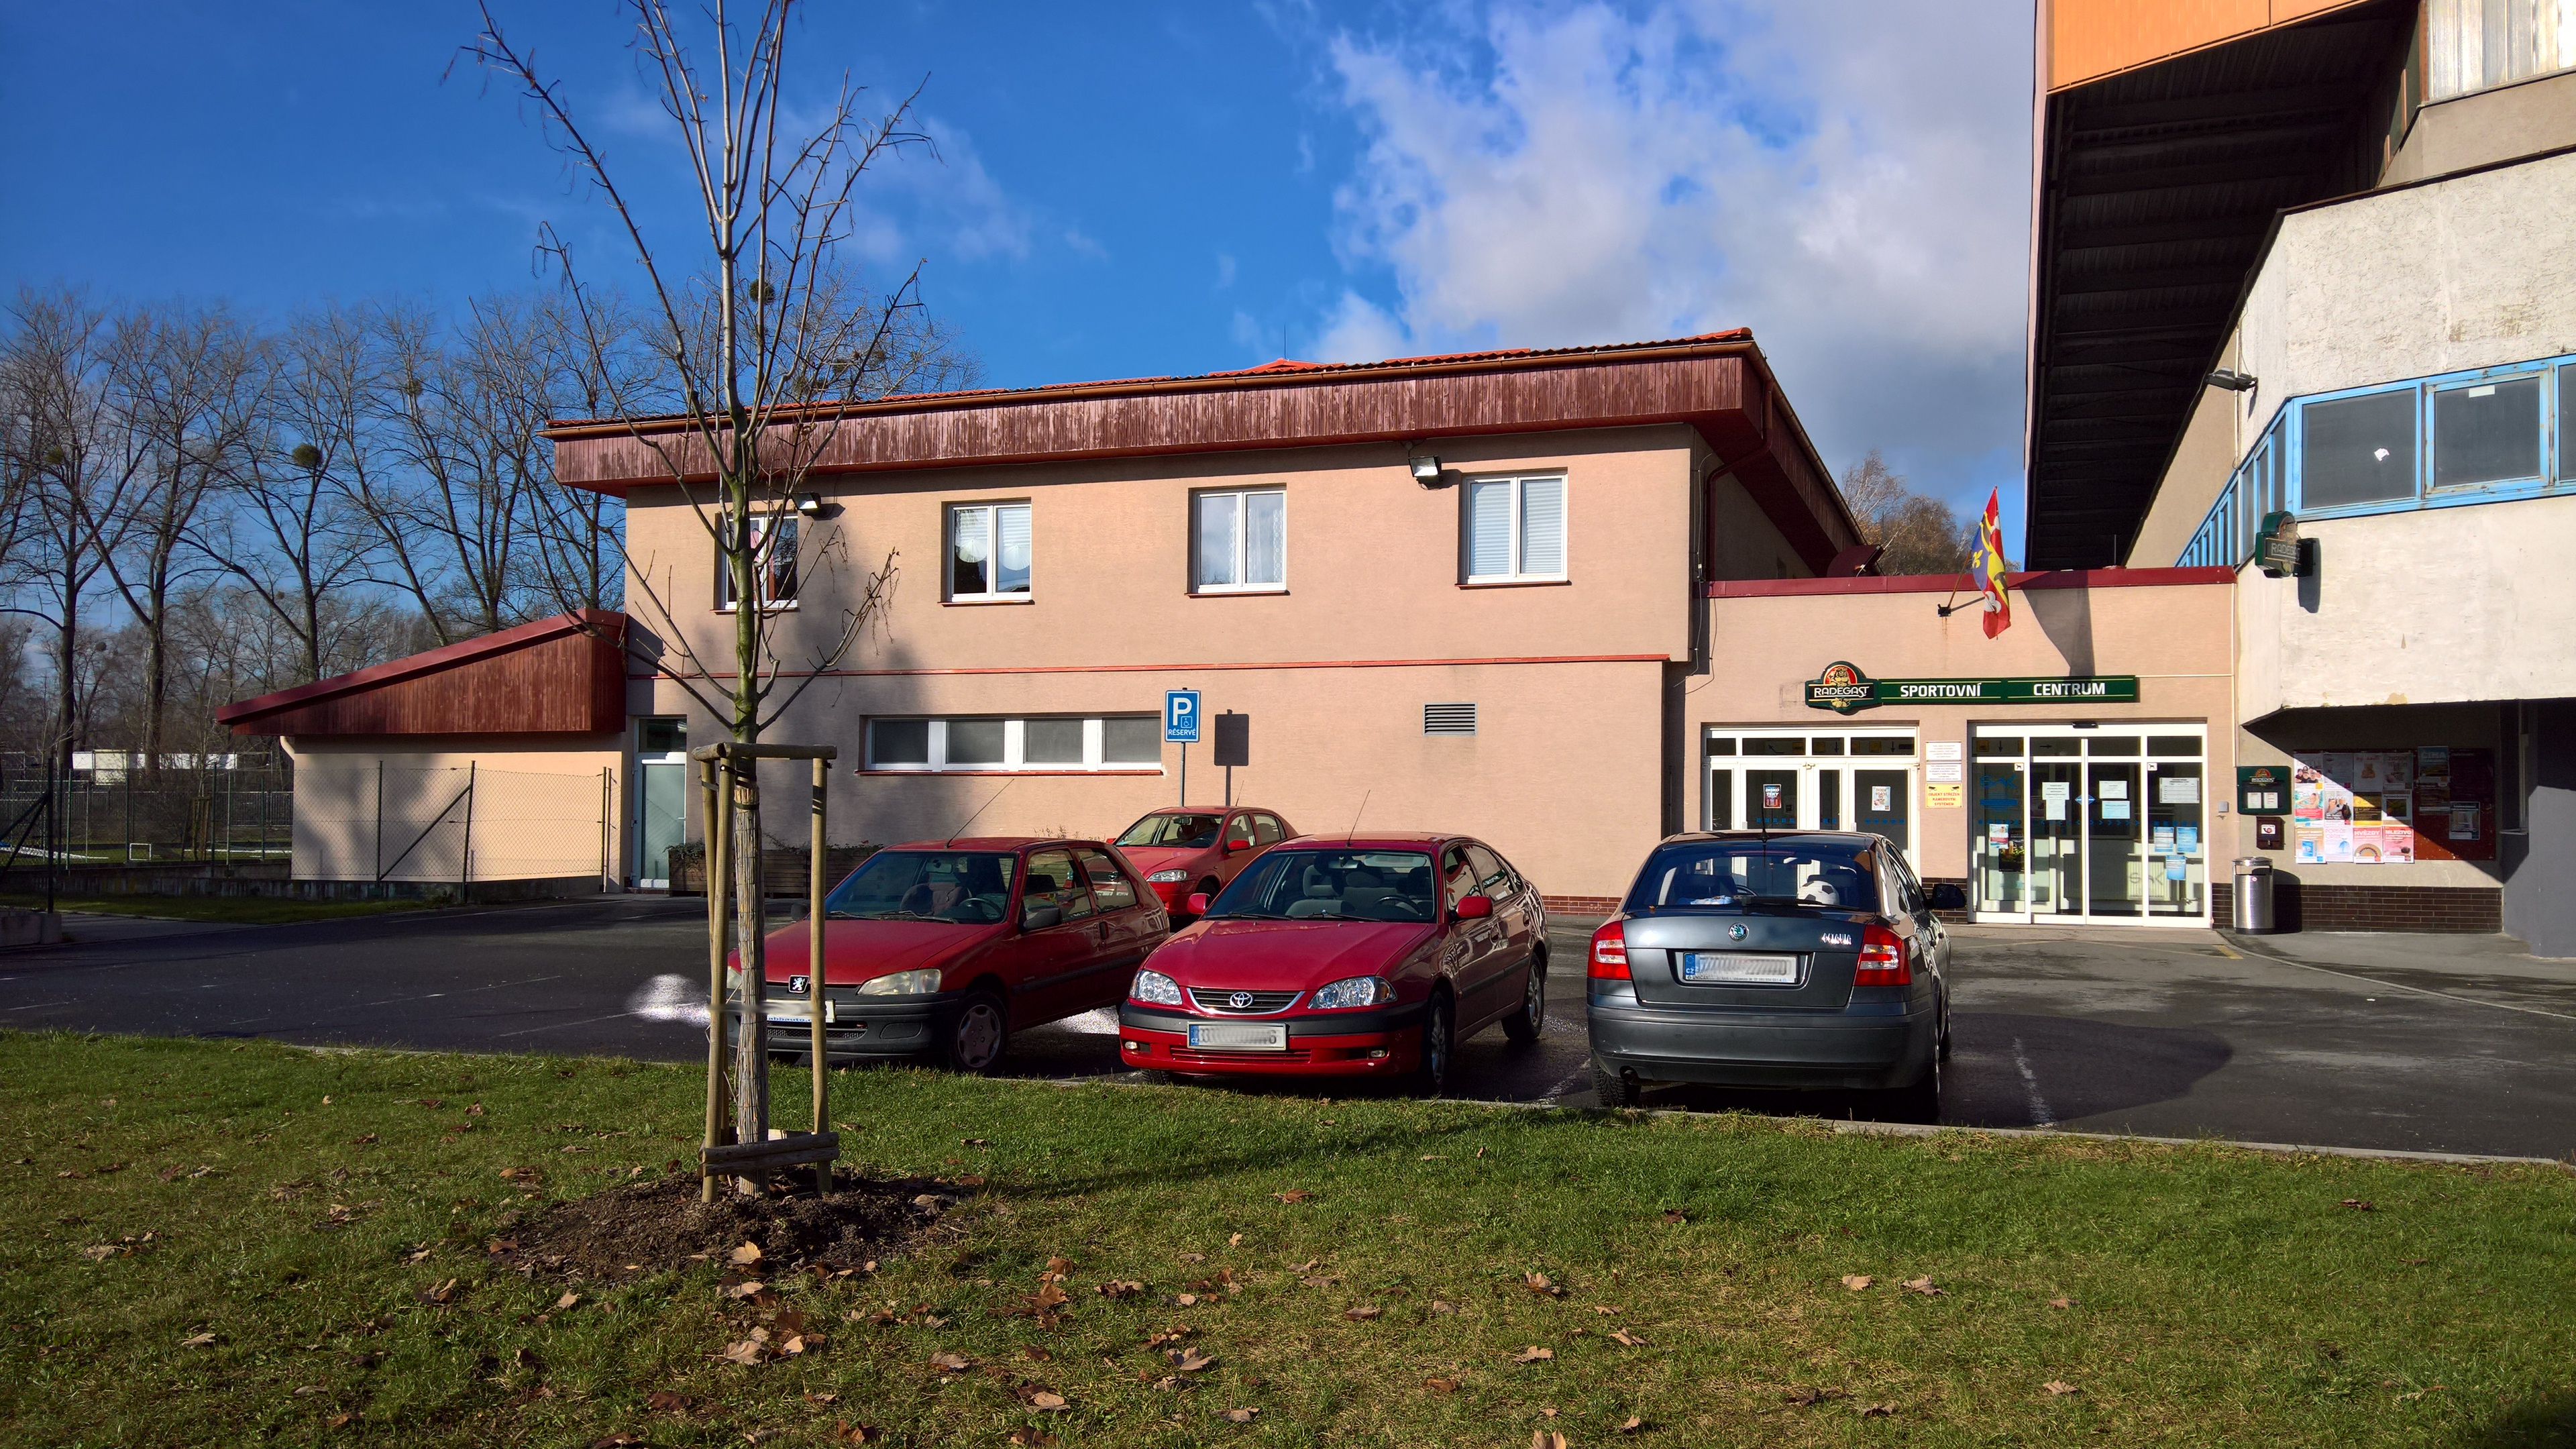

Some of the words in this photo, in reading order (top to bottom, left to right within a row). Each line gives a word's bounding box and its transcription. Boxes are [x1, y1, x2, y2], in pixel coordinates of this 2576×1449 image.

[1814, 686, 1870, 698] RADEGAST
[1900, 682, 1982, 697] SPORTOVNÍ
[2033, 683, 2106, 696] CENTRUM
[1173, 698, 1192, 726] P
